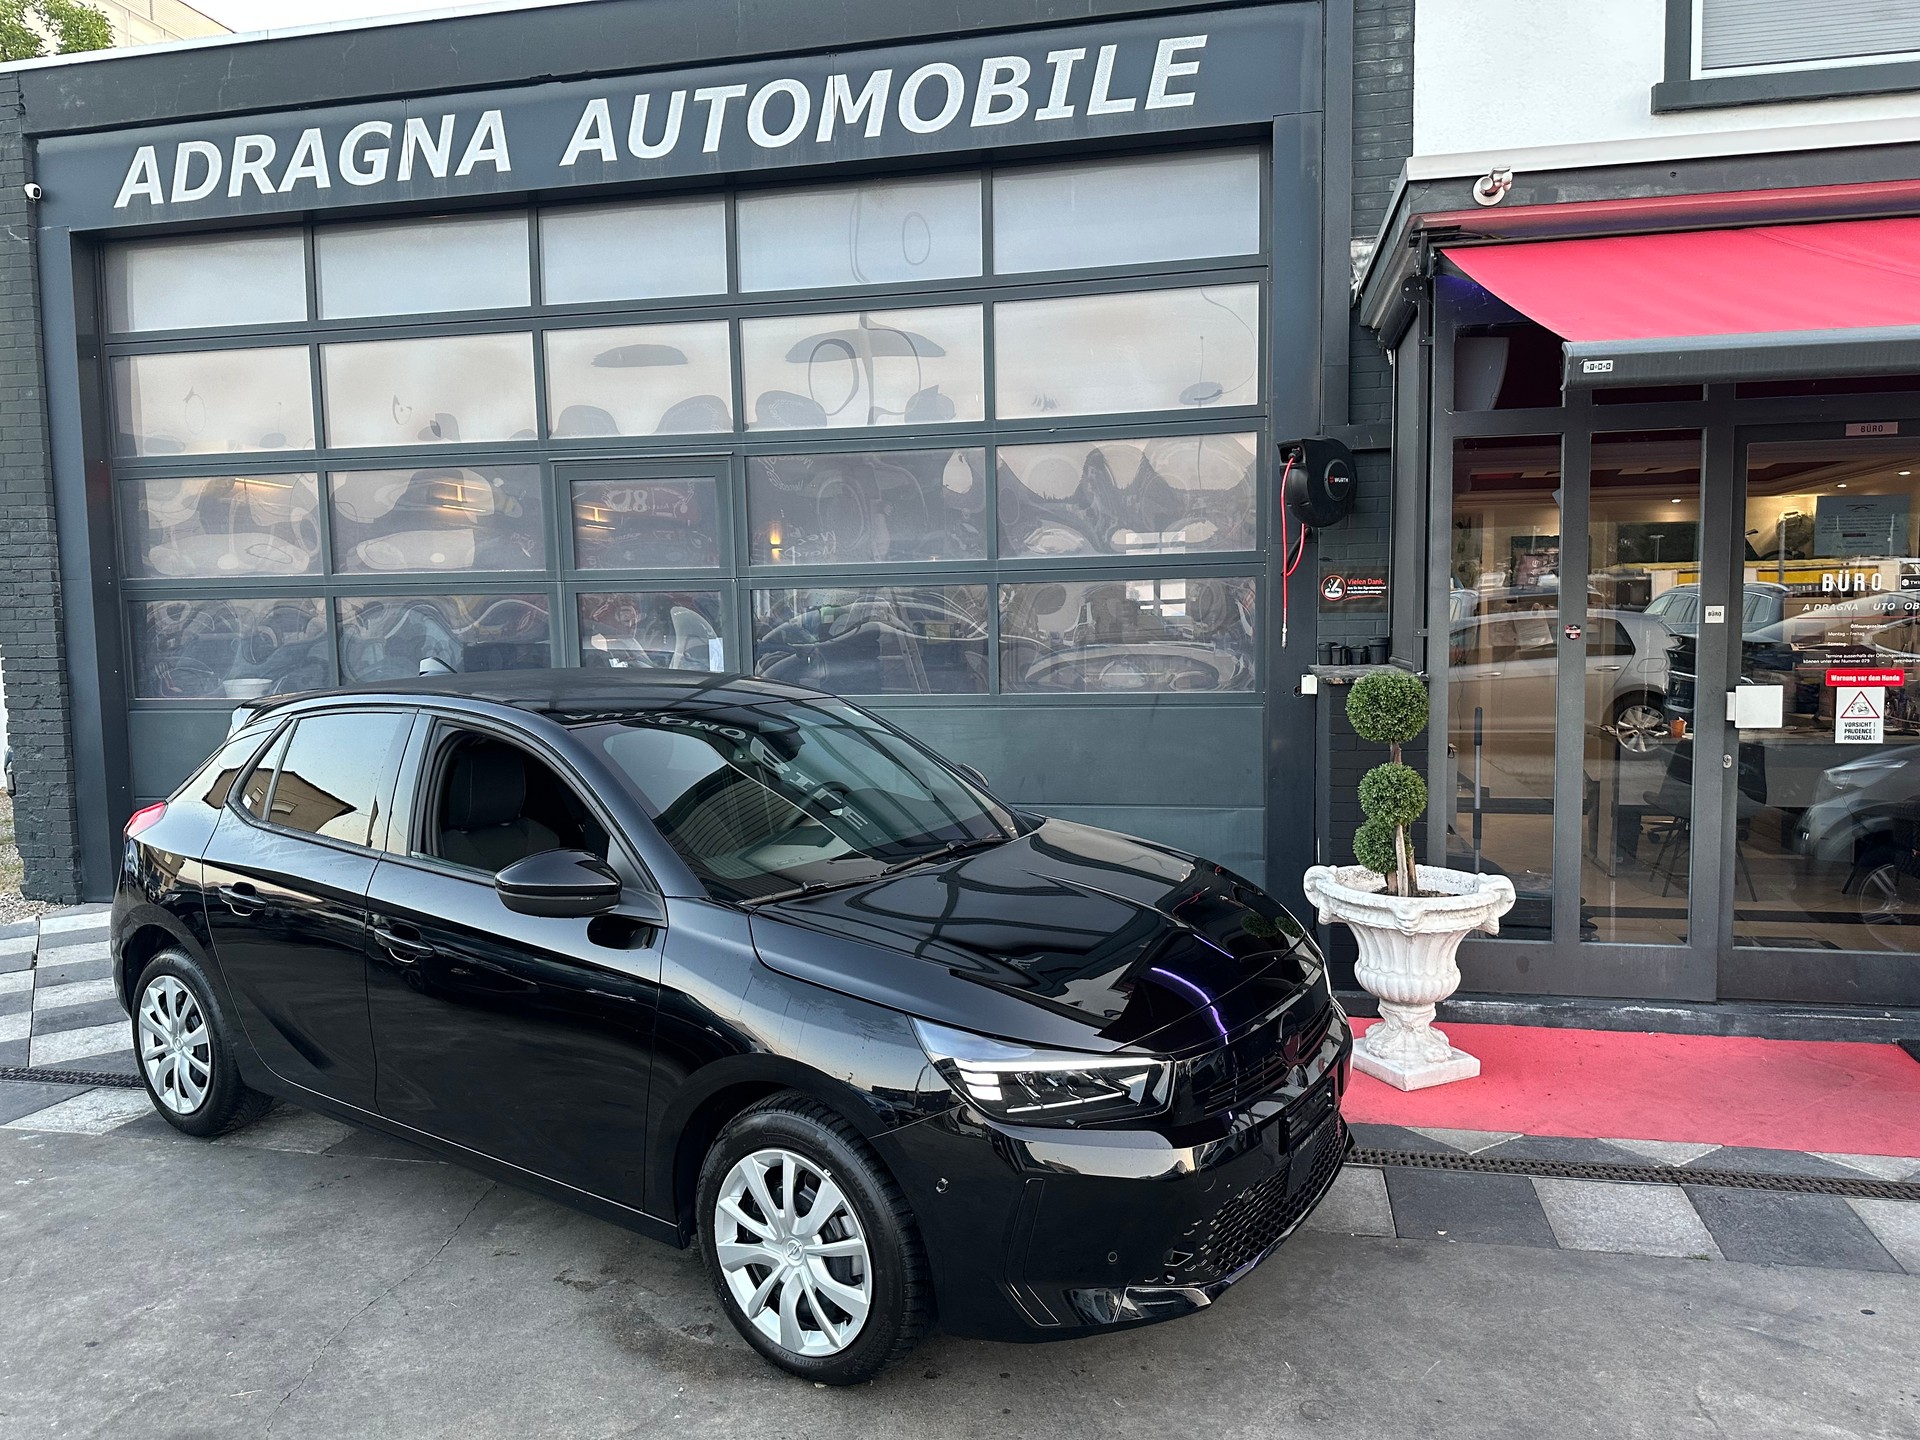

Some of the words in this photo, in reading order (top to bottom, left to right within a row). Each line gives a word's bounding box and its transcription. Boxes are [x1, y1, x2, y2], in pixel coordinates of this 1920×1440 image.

[113, 109, 512, 209] ADRAGNA
[559, 34, 1209, 167] AUTOMOBILE
[1860, 424, 1884, 433] BÜRO
[1821, 569, 1882, 592] BÜRO
[1830, 674, 1856, 682] Warnung
[1868, 674, 1881, 682] dem
[1881, 674, 1900, 682] Hunde
